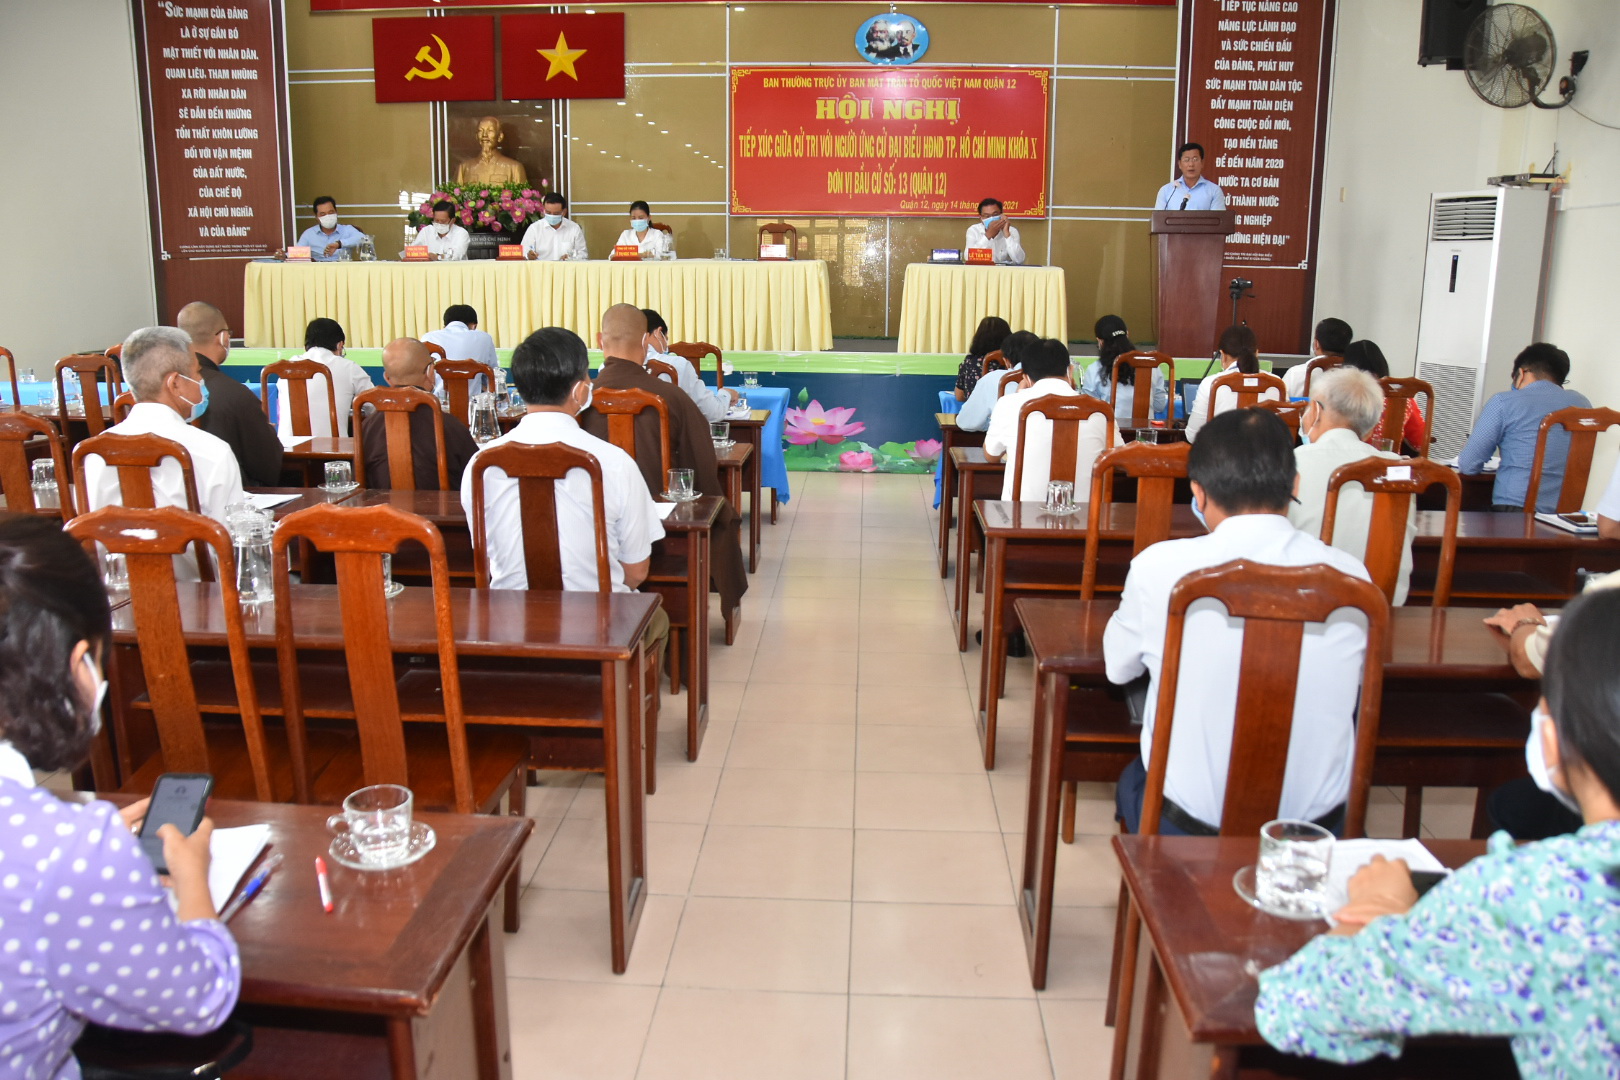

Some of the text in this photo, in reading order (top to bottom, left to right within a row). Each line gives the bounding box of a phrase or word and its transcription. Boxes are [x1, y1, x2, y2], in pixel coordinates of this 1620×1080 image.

[186, 8, 208, 20] MẠNH
[211, 6, 226, 18] CỦA
[227, 6, 248, 19] ĐẢNG
[1242, 1, 1256, 13] TỤC
[1283, 2, 1298, 12] CAO
[180, 26, 190, 38] LÀ
[199, 27, 209, 40] SỰ
[228, 27, 238, 39] BÓ
[1218, 19, 1296, 34] NĂNG LỰC LÃNH ĐẠO
[1222, 38, 1292, 52] VÀ SỨC CHIẾN ĐẤU
[163, 46, 179, 60] MẬT
[181, 45, 201, 59] THIẾT
[204, 47, 216, 59] VỚI
[218, 47, 239, 59] NHÂN
[1215, 57, 1230, 70] CỦA
[1257, 59, 1277, 71] PHÁT
[1279, 62, 1294, 71] HUY
[166, 68, 186, 79] QUAN
[208, 69, 229, 79] THAM
[231, 68, 258, 80] NHŨNG
[764, 78, 779, 88] BAN
[781, 75, 812, 88] THƯỜNG
[814, 77, 834, 90] TRỰC
[837, 74, 847, 88] ỦY
[850, 78, 865, 88] BAN
[922, 74, 942, 89] QUỐC
[945, 77, 962, 90] VIỆT
[964, 79, 981, 88] NAM
[984, 77, 1004, 90] QUẬN
[1007, 79, 1016, 88] 12
[1206, 77, 1302, 93] SỨC MẠNH TOÀN DÂN TỘC
[182, 87, 246, 99] XA RỜI NHÂN DÂN
[816, 93, 959, 125] HỘI NGHỊ
[1211, 95, 1293, 112] ĐẨY MẠNH TOÀN DIỆN
[179, 106, 252, 119] SẼ DẪN ĐẾN NHỮNG
[1214, 117, 1235, 129] CÔNG
[1237, 117, 1257, 131] CUỘC
[1259, 115, 1272, 130] ĐỔI
[175, 124, 258, 139] TỔN THẤT KHÔN LƯỜNG
[739, 126, 756, 158] TIẾP
[758, 129, 773, 158] XÚC
[775, 130, 792, 158] GIỮA
[794, 126, 804, 158] CỬ
[806, 135, 818, 158] TRI
[820, 129, 832, 158] VỚI
[835, 129, 857, 158] NGƯỜI
[859, 129, 874, 158] ỨNG
[876, 127, 887, 158] CỬ
[904, 124, 921, 158] BIỂU
[924, 136, 944, 159] HĐND
[946, 136, 958, 159] TP.
[972, 130, 986, 159] CHÍ
[987, 136, 1006, 159] MINH
[1008, 130, 1029, 159] KHÓA
[1030, 138, 1037, 159] X
[1224, 138, 1237, 150] TẠO
[1258, 136, 1278, 149] TẢNG
[184, 145, 252, 160] ĐỐI VỚI VẬN MỆNH
[1216, 153, 1284, 169] ĐỂ ĐẾN NĂM 2020
[193, 166, 208, 178] CỦA
[209, 165, 223, 178] ĐẤT
[828, 168, 843, 194] ĐƠN
[845, 172, 852, 199] VỊ
[855, 162, 869, 194] BẦU
[872, 164, 882, 194] CỬ
[899, 172, 907, 194] 13
[910, 166, 932, 199] (QUẬN
[935, 172, 947, 197] 12)
[1218, 175, 1279, 188] NƯỚC TA CƠ BẢN
[199, 185, 241, 199] CỦA CHẾ ĐỘ
[900, 200, 918, 210] Quận
[932, 201, 948, 211] ngày
[950, 201, 958, 209] 14
[1003, 201, 1018, 210] 2021
[1232, 195, 1257, 206] THÀNH
[1259, 195, 1279, 207] NƯỚC
[188, 205, 253, 218] XÃ HỘI CHỦ NGHĨA
[1244, 213, 1272, 227] NGHIỆP
[199, 225, 209, 237] VÀ
[211, 224, 225, 237] CỦA
[1253, 233, 1270, 246] HIỆN
